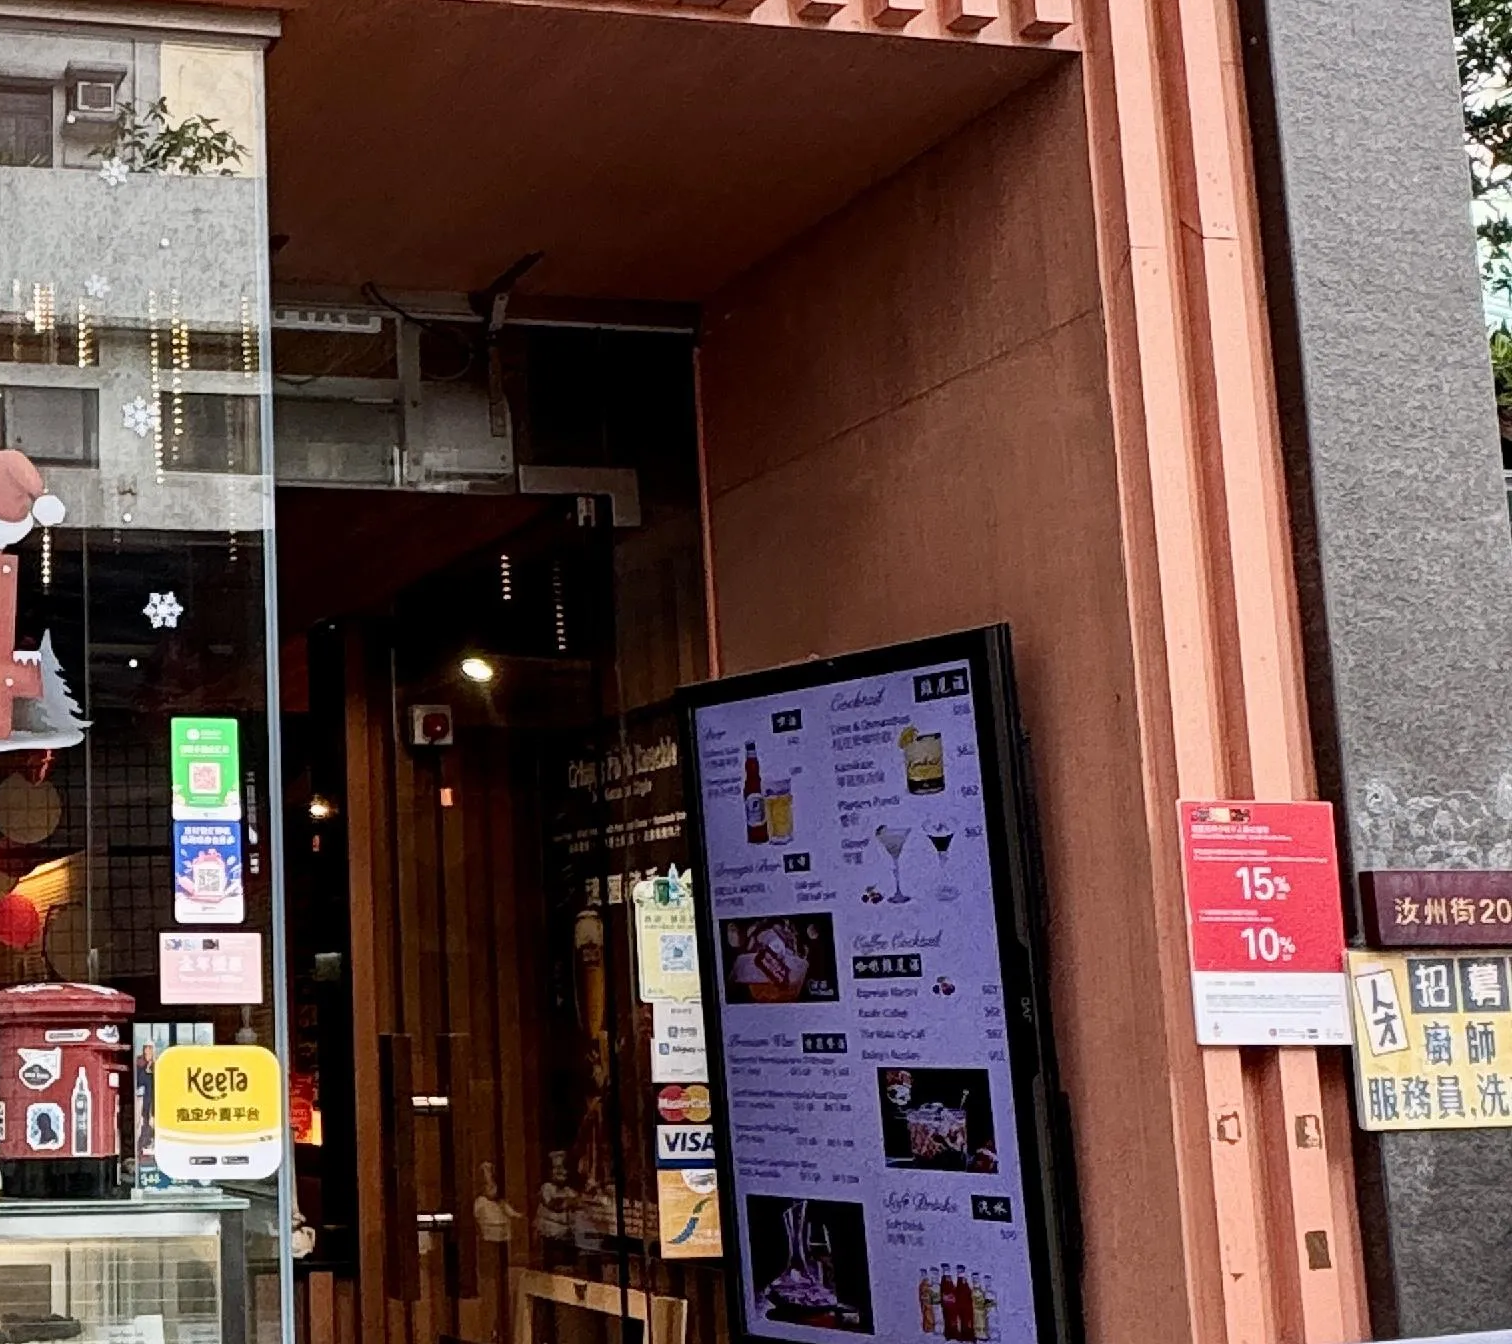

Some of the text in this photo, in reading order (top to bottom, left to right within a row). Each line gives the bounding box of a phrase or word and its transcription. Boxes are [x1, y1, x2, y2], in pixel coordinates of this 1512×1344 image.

[1394, 896, 1512, 927] 汝州街20
[186, 1066, 249, 1100] KeeTa
[664, 1131, 716, 1152] VISA
